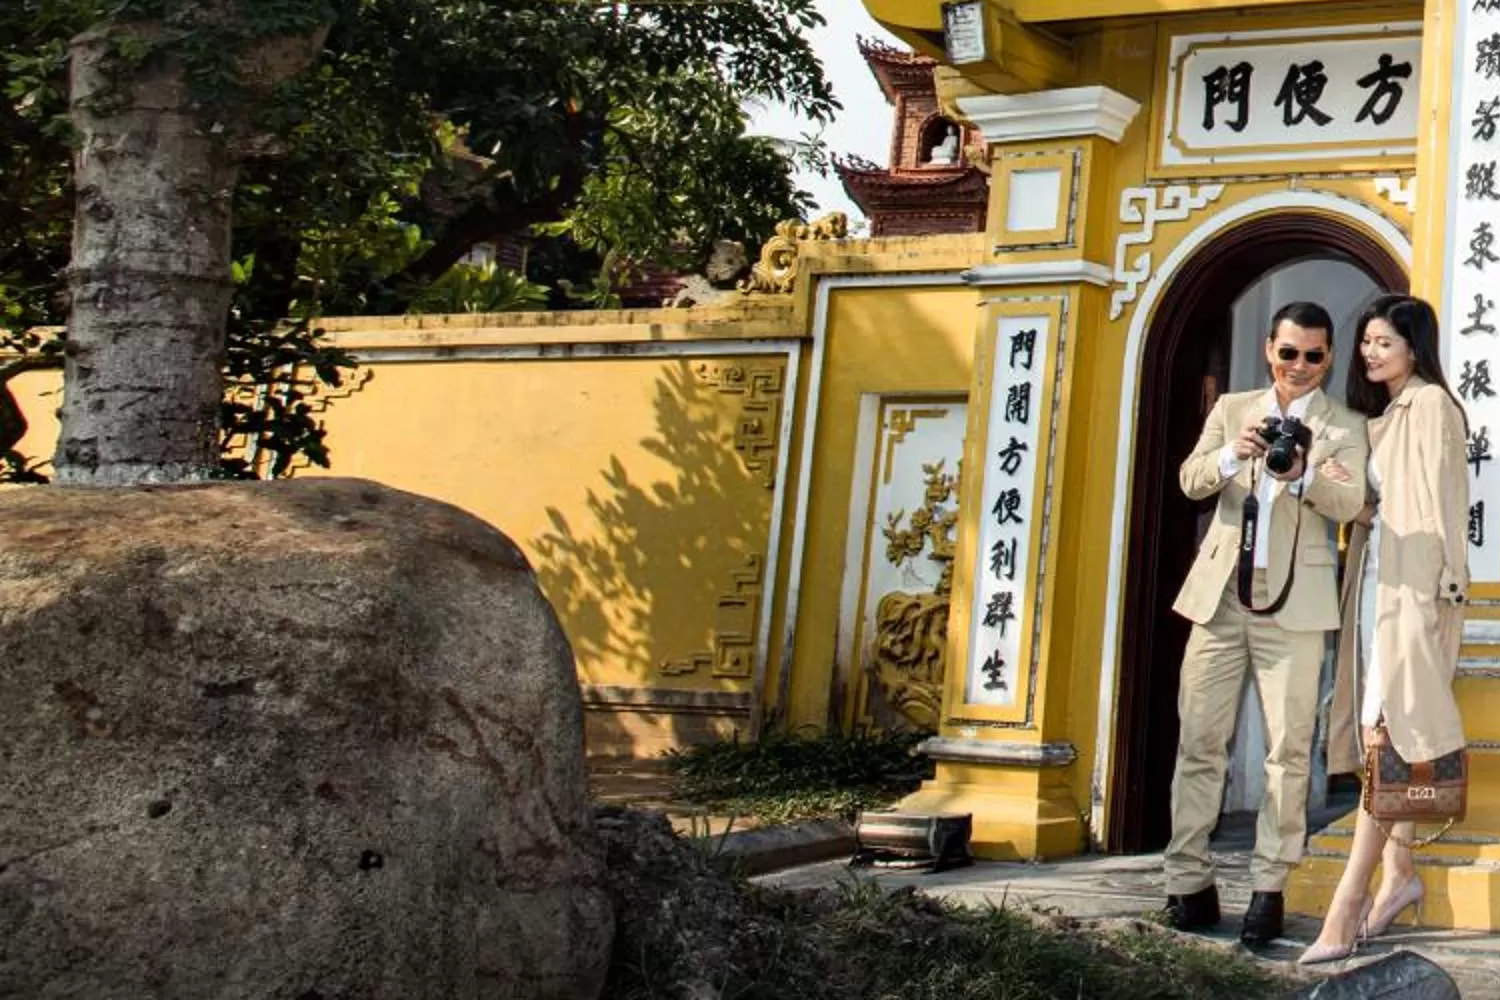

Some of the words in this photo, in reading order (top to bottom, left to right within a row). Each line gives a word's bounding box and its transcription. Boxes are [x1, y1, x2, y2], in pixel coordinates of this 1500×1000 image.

[981, 329, 1038, 692] 門開方便利群生
